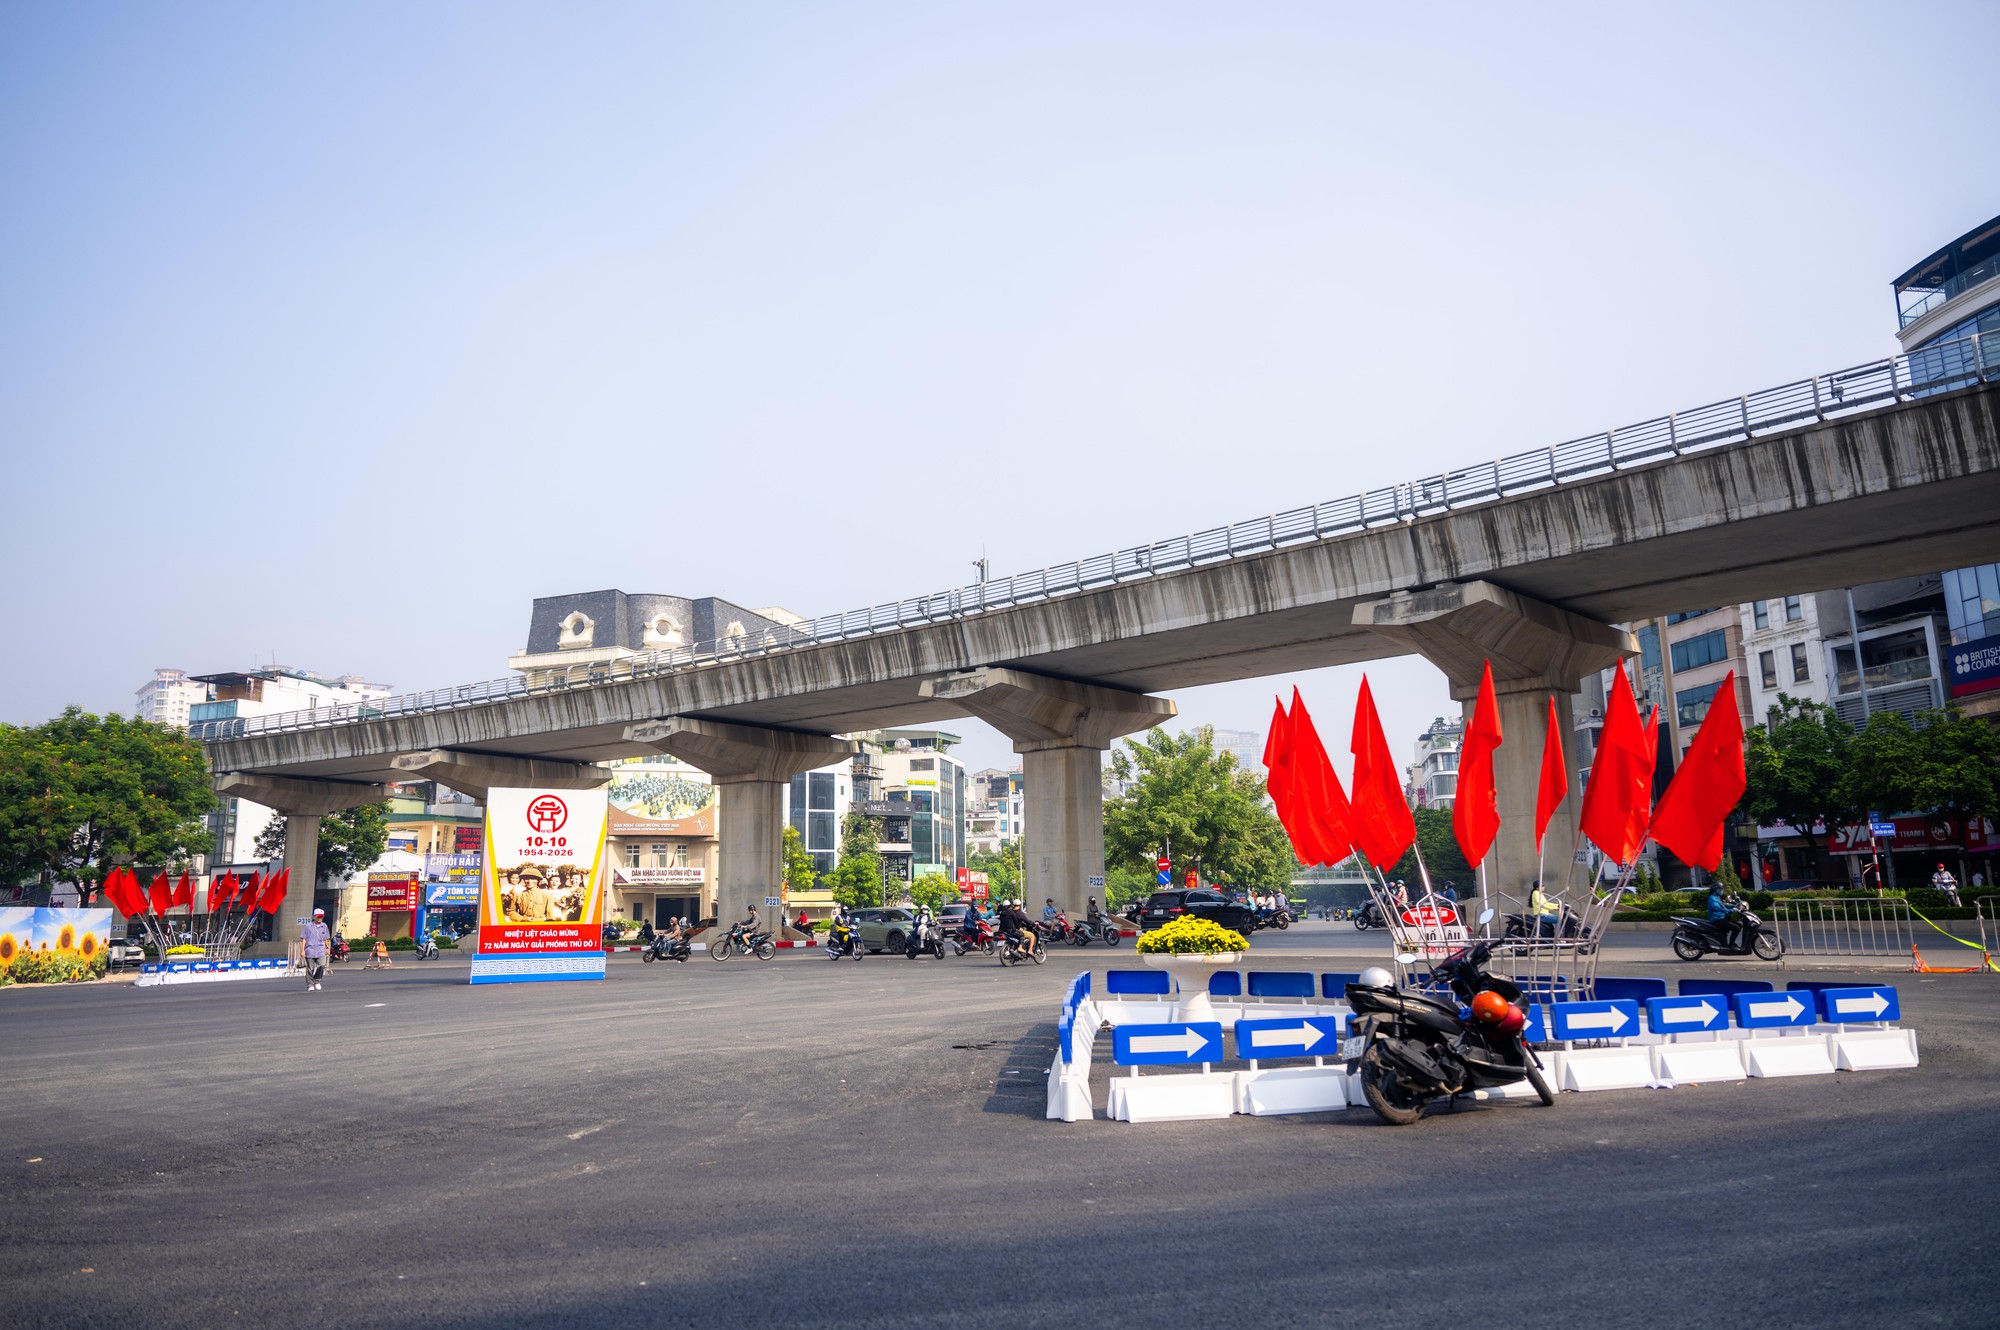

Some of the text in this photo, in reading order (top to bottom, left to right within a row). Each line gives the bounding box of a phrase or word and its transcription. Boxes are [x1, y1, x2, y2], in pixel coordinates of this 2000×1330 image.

[1970, 646, 2000, 661] BRITISH
[526, 837, 567, 846] 10-10
[459, 854, 474, 866] HẢI
[1090, 878, 1103, 886] P322
[505, 930, 523, 939] NHIỆT
[525, 930, 538, 938] LIỆT
[559, 928, 578, 936] MỪNG
[531, 939, 544, 948] GIẢI
[569, 939, 581, 947] THỦ
